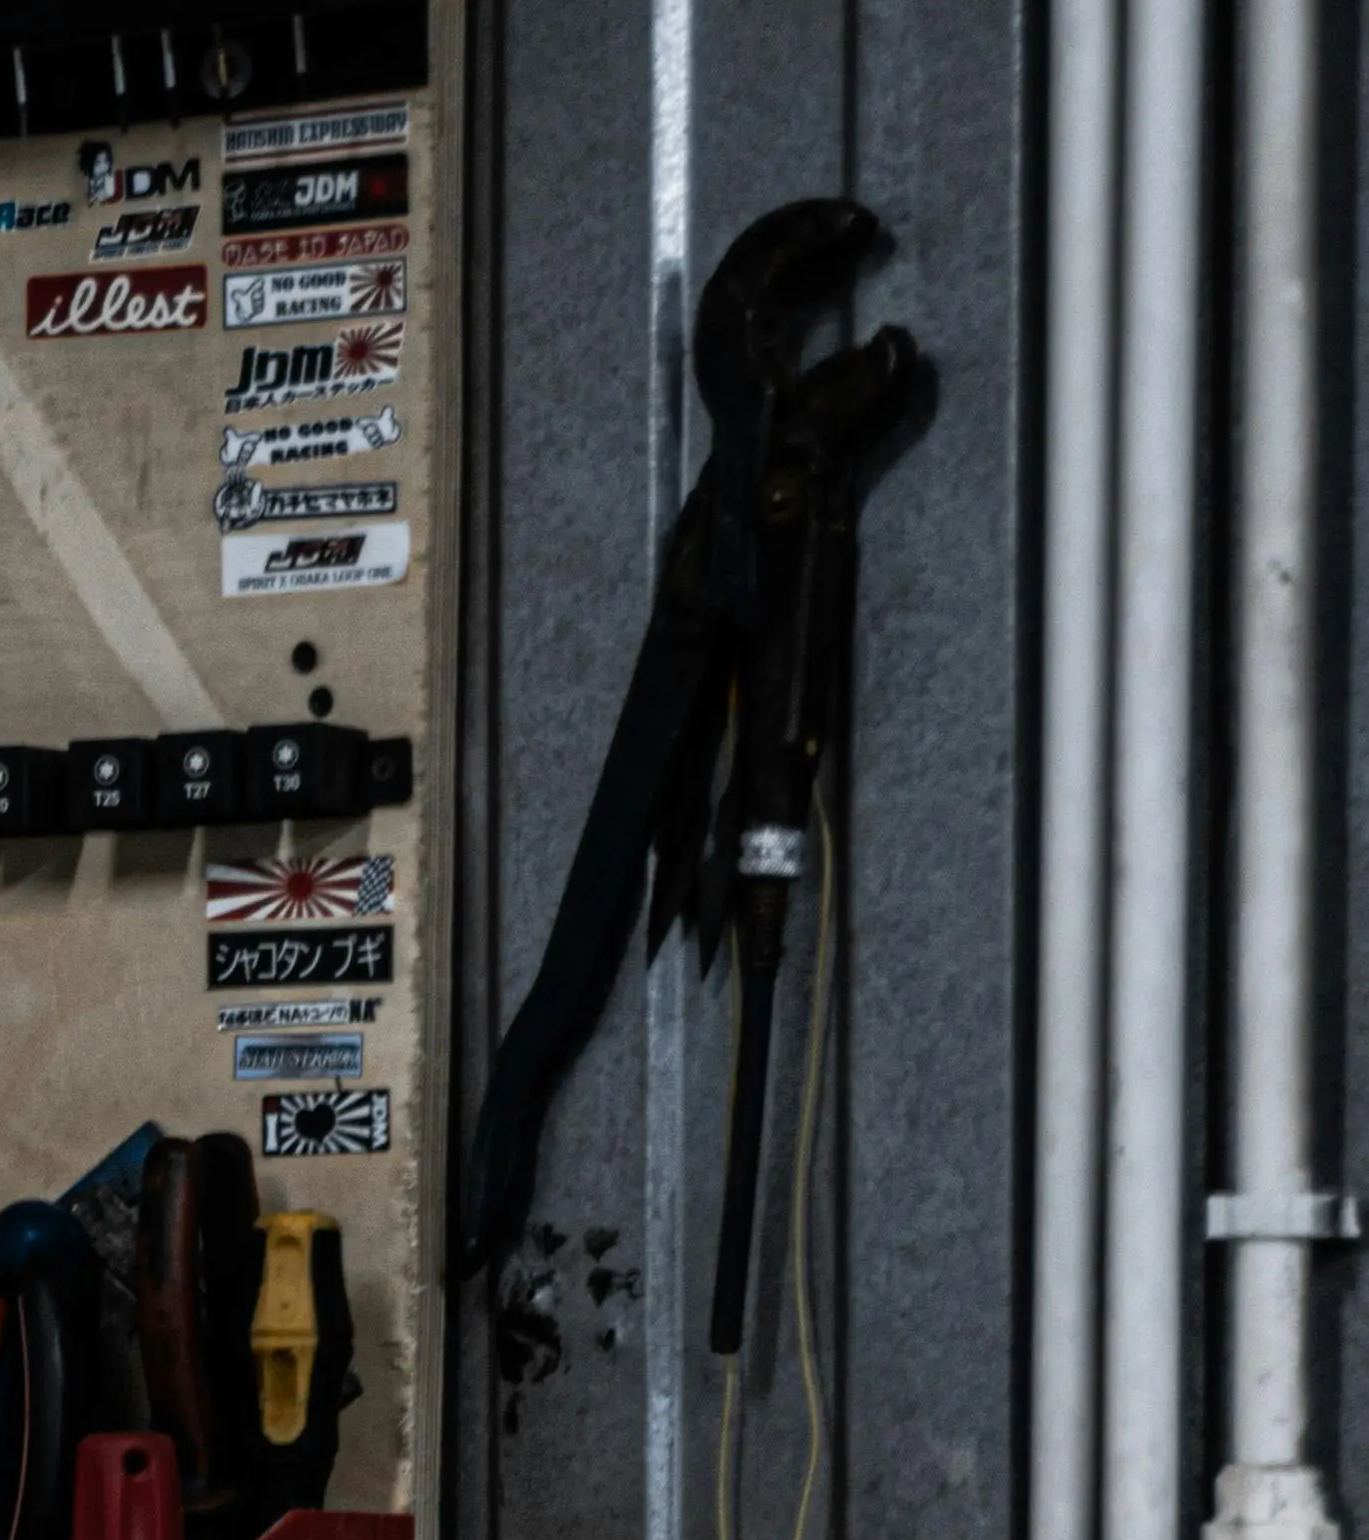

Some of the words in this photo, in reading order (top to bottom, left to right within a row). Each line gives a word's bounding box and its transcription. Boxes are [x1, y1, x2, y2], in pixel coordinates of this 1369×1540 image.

[294, 169, 360, 207] JDM
[271, 275, 294, 292] NO
[298, 271, 347, 290] GOOD
[29, 273, 205, 338] illest
[276, 296, 342, 318] RACING
[225, 345, 334, 397] JDM
[264, 425, 292, 444] NO
[298, 417, 353, 438] GOOD
[270, 440, 349, 465] RACING
[182, 780, 212, 801] T27
[273, 771, 302, 793] T30
[93, 788, 122, 809] T25
[369, 1092, 388, 1150] JDM
